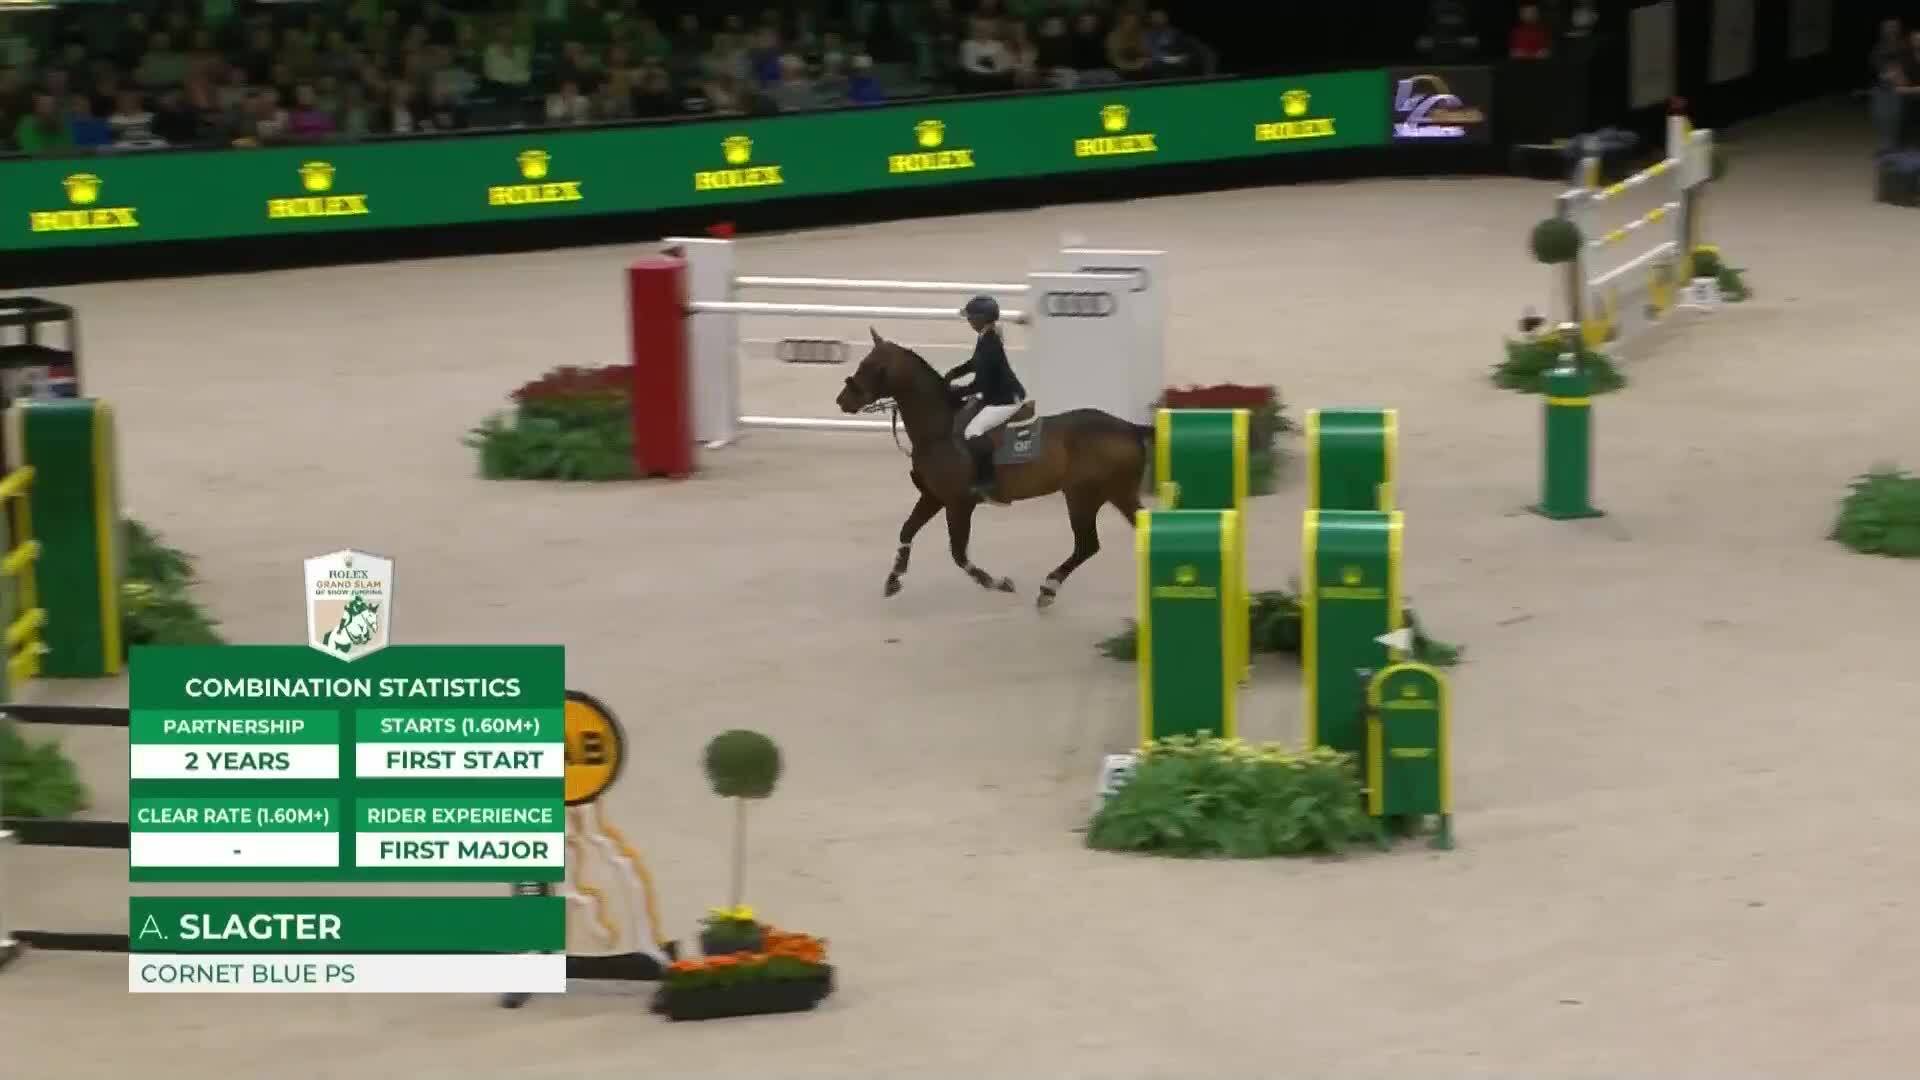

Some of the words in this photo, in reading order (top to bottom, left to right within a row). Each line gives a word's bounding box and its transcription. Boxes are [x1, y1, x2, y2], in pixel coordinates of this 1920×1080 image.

[1254, 118, 1336, 141] ROLEX
[1074, 133, 1157, 157] ROLEX
[888, 149, 975, 173] ROLEX
[694, 166, 784, 190] ROLEX
[487, 181, 584, 206] ROLEX
[267, 194, 369, 218] ROLEX
[30, 207, 139, 232] ROLEX
